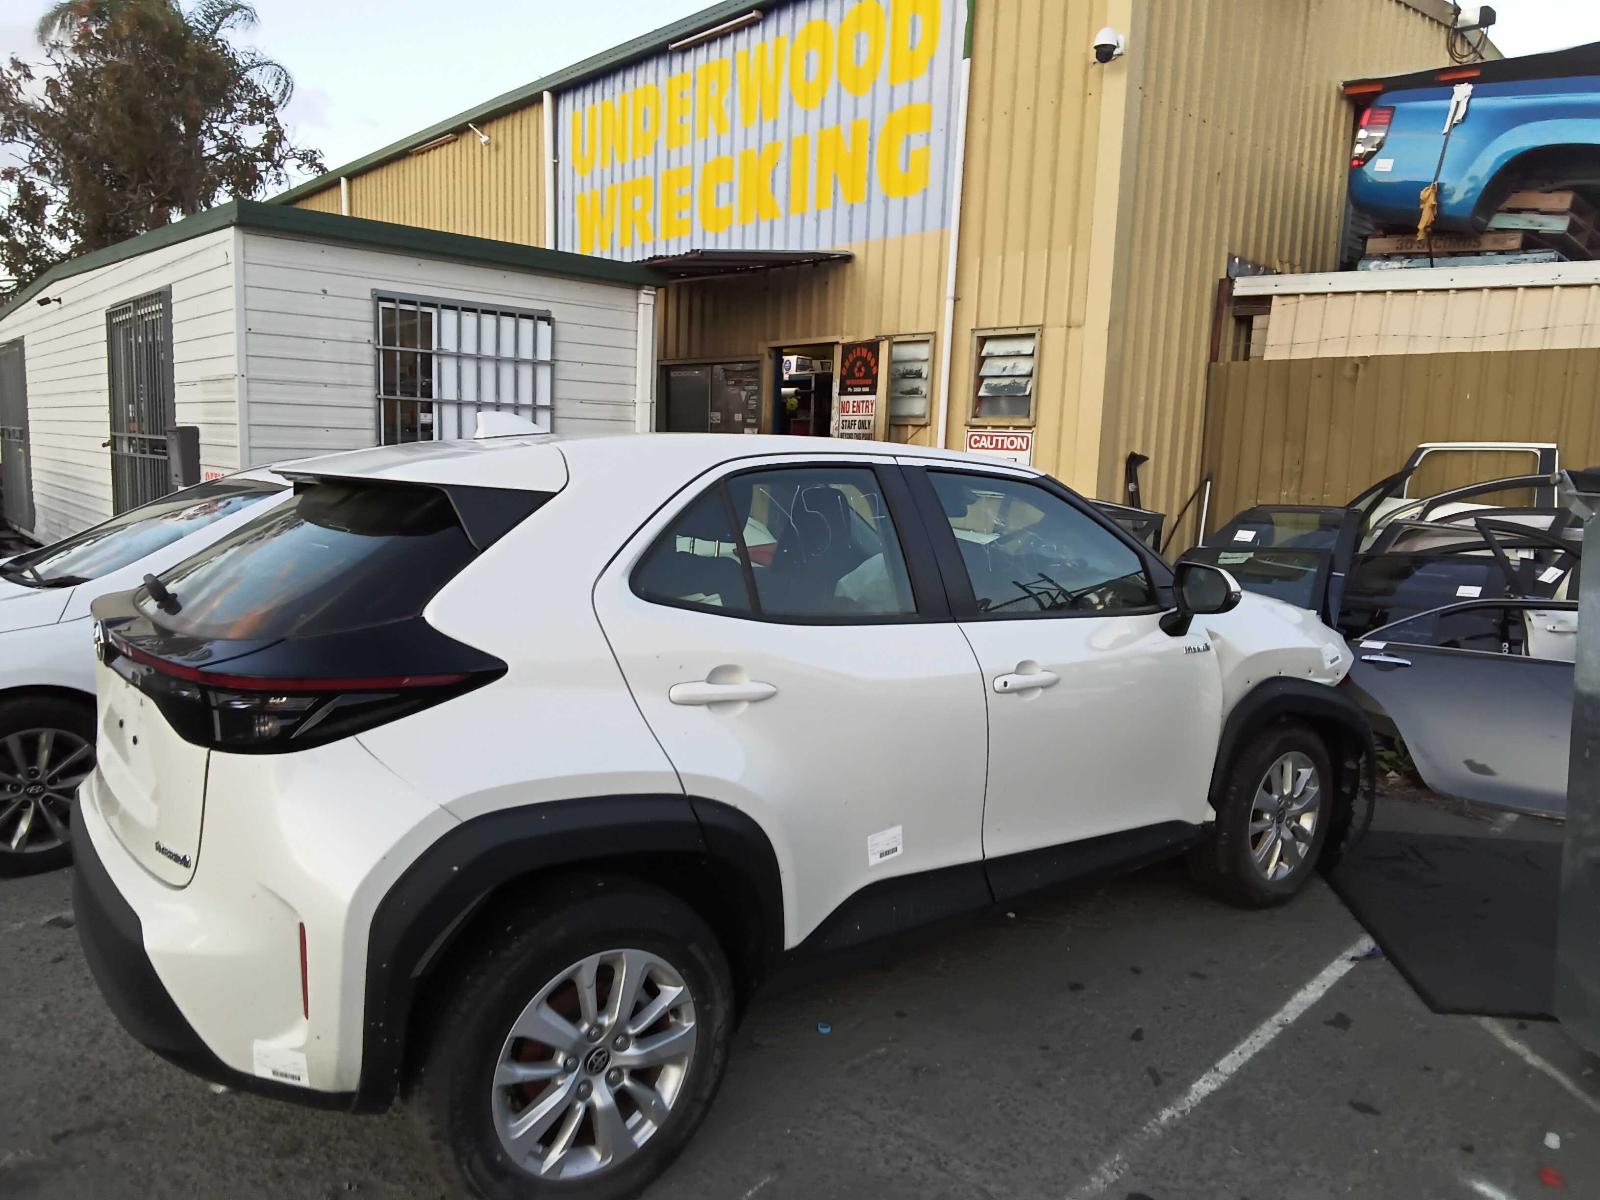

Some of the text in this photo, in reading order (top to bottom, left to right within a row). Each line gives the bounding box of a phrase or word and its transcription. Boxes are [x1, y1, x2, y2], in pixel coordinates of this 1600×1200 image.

[571, 0, 942, 177] UNDERWOOD
[576, 103, 932, 255] WRECKING
[841, 399, 875, 414] NO ENTRY
[841, 419, 872, 430] STAFF ONLY
[970, 435, 1028, 450] CAUTION
